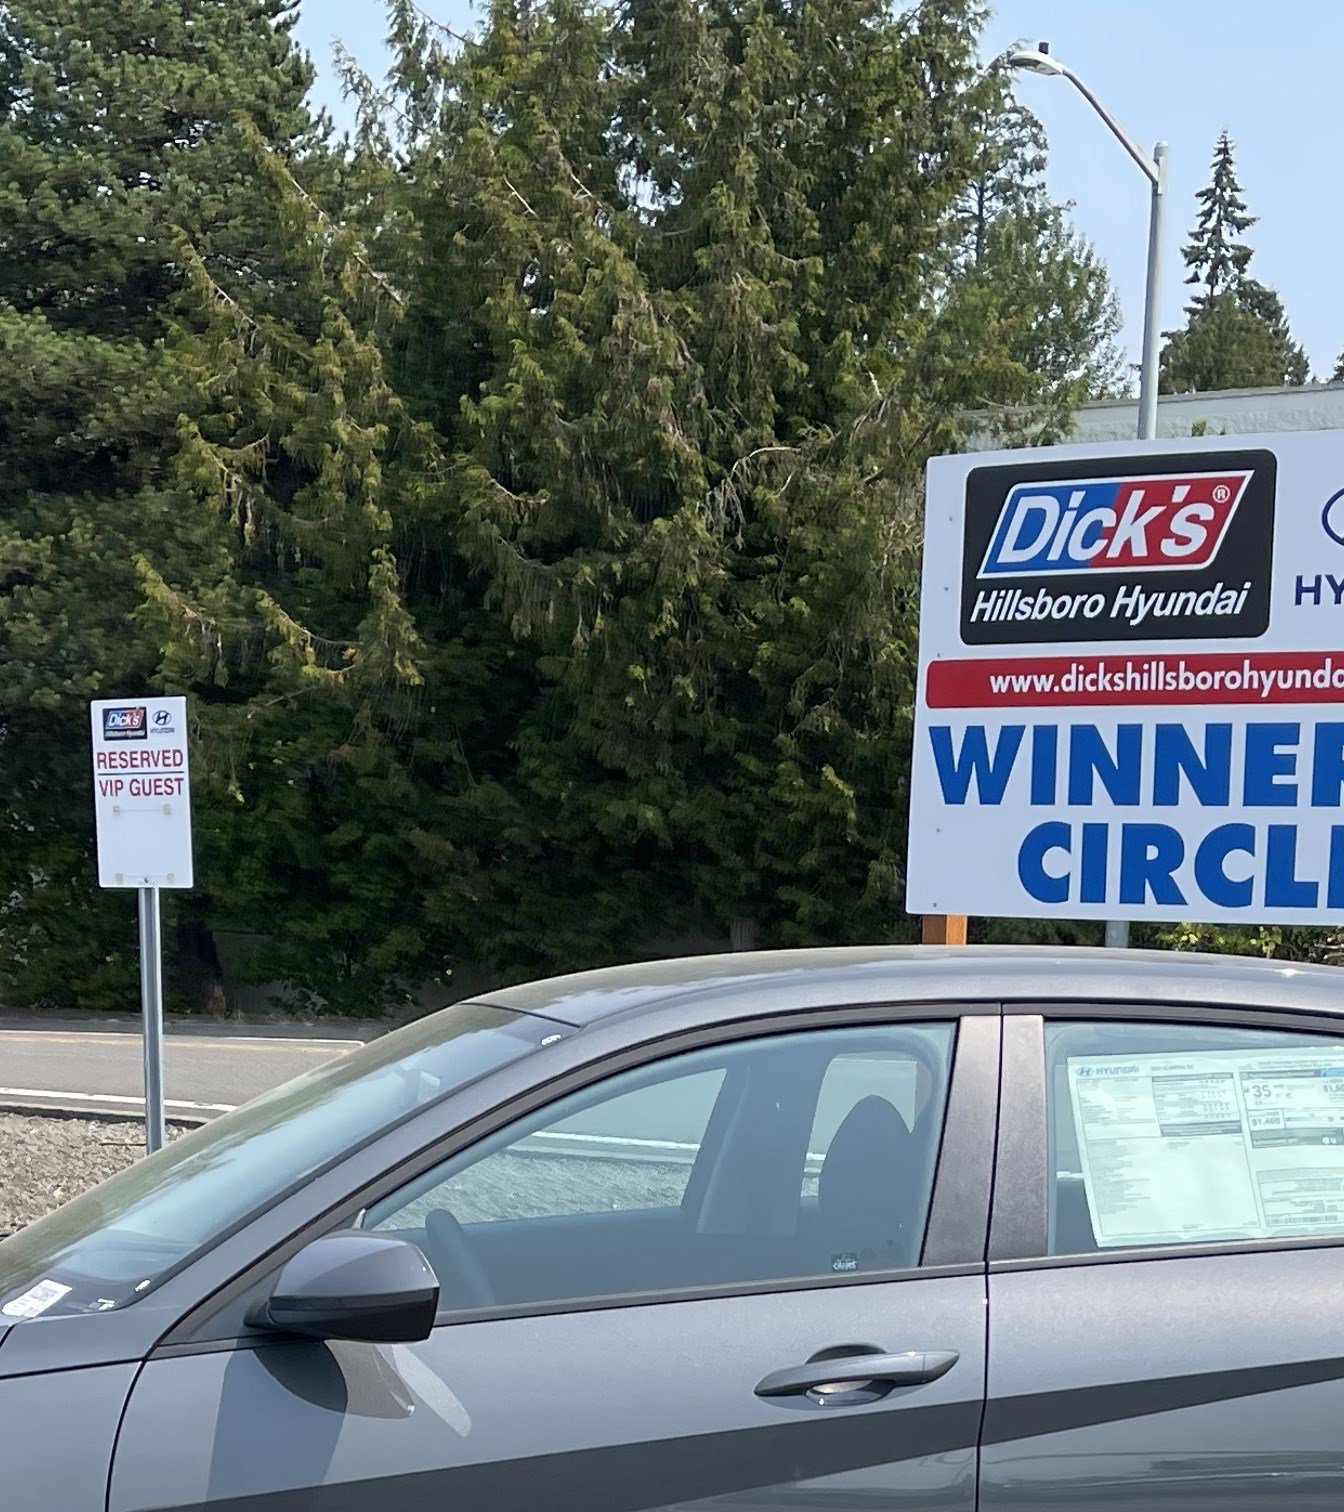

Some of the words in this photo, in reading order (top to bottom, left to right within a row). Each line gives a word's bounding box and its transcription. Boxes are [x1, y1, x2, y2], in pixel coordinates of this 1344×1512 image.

[969, 588, 1105, 623] Hillsboro
[1109, 581, 1252, 627] Hyundai
[96, 749, 184, 770] RESERVED
[98, 779, 124, 797] VIP
[129, 777, 184, 797] GUEST
[1251, 1084, 1272, 1098] 35
